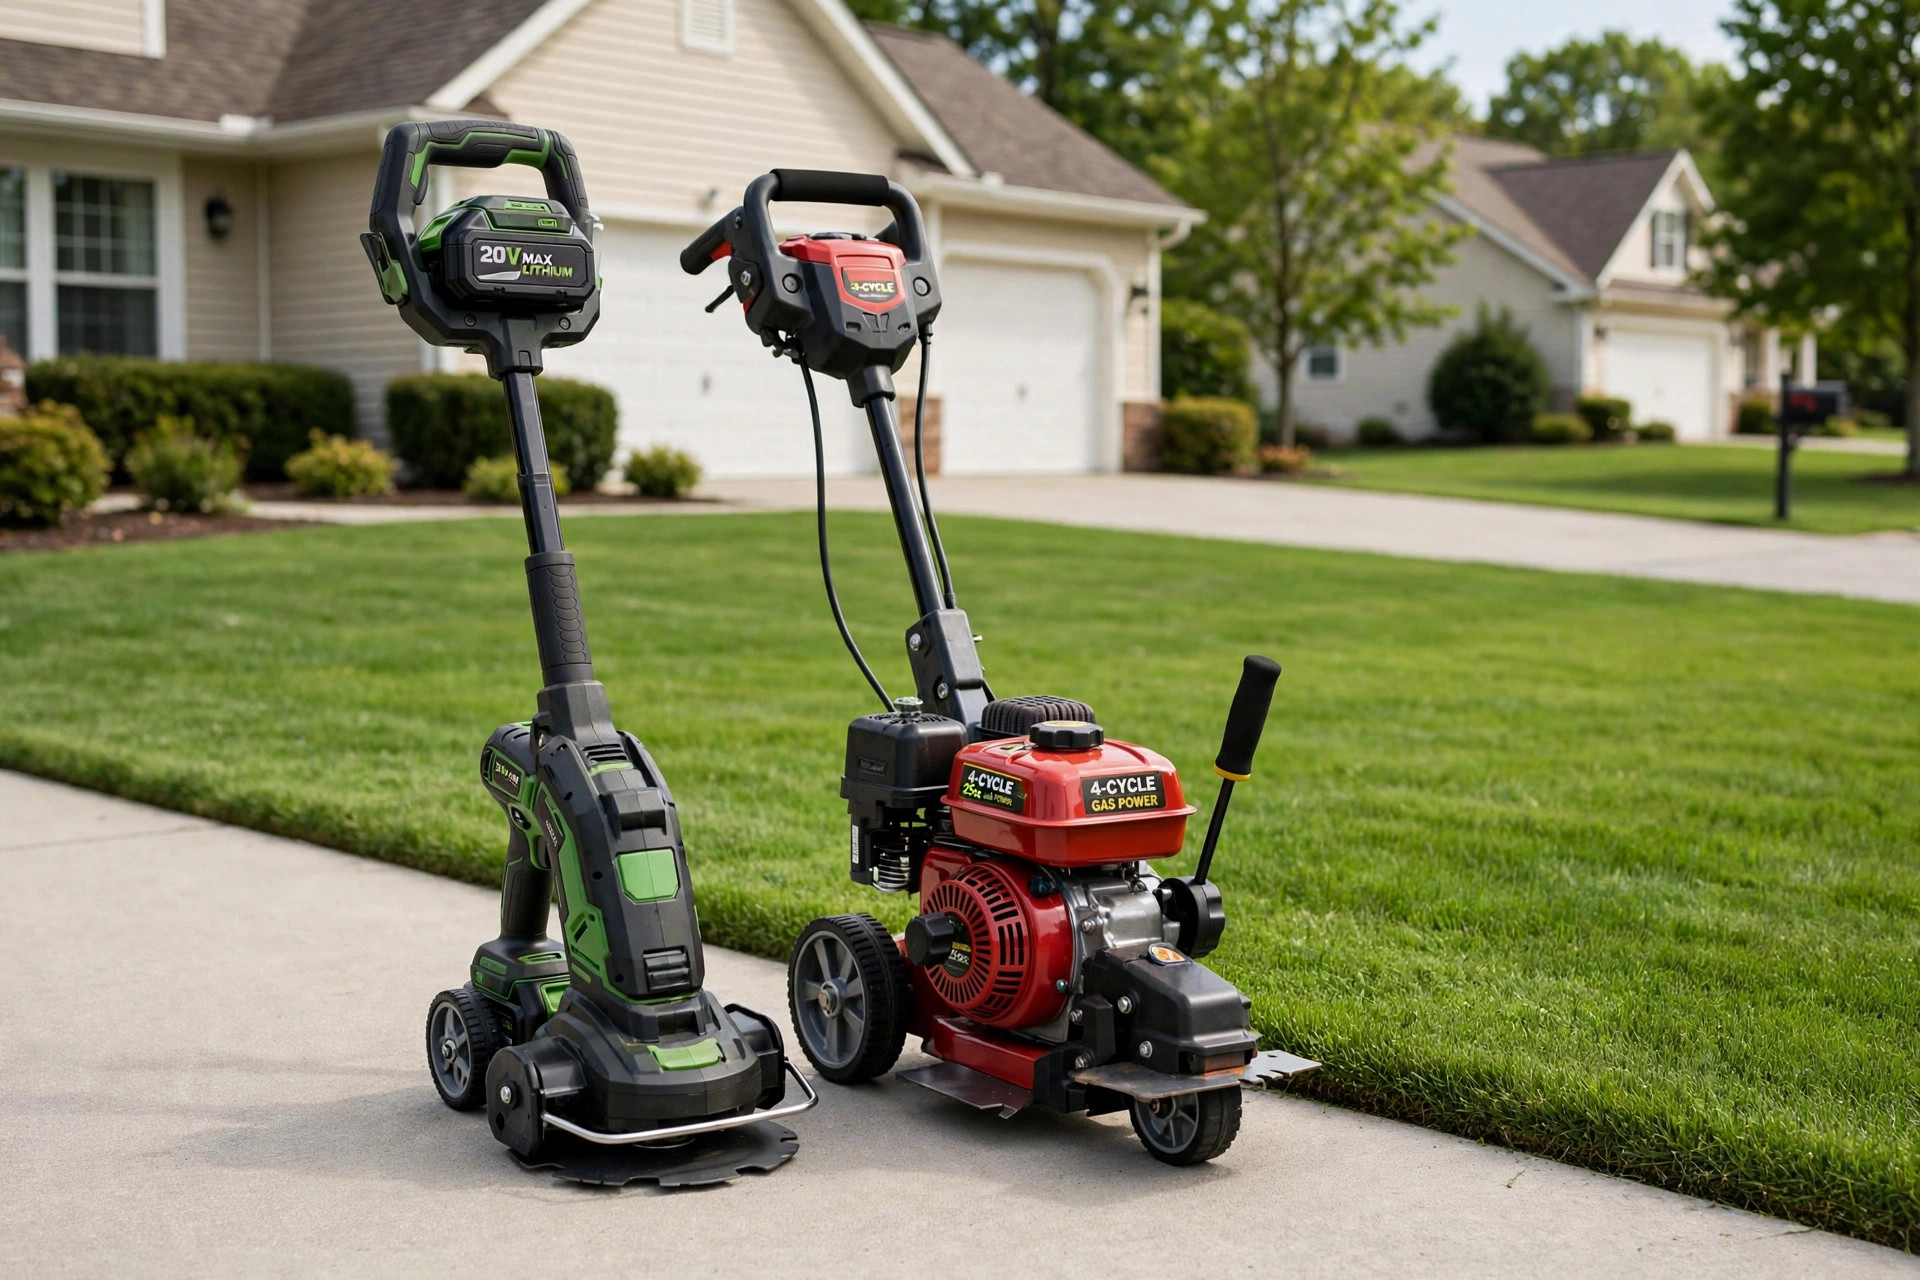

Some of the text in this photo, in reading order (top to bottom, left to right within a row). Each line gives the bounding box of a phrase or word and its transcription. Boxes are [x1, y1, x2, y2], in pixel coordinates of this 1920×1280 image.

[480, 245, 553, 266] 20V MAX
[522, 265, 573, 278] LITHIUM
[968, 770, 1014, 795] 4-CYCLE
[1090, 775, 1156, 796] 4-CYCLE
[1091, 794, 1158, 812] GAS POWER
